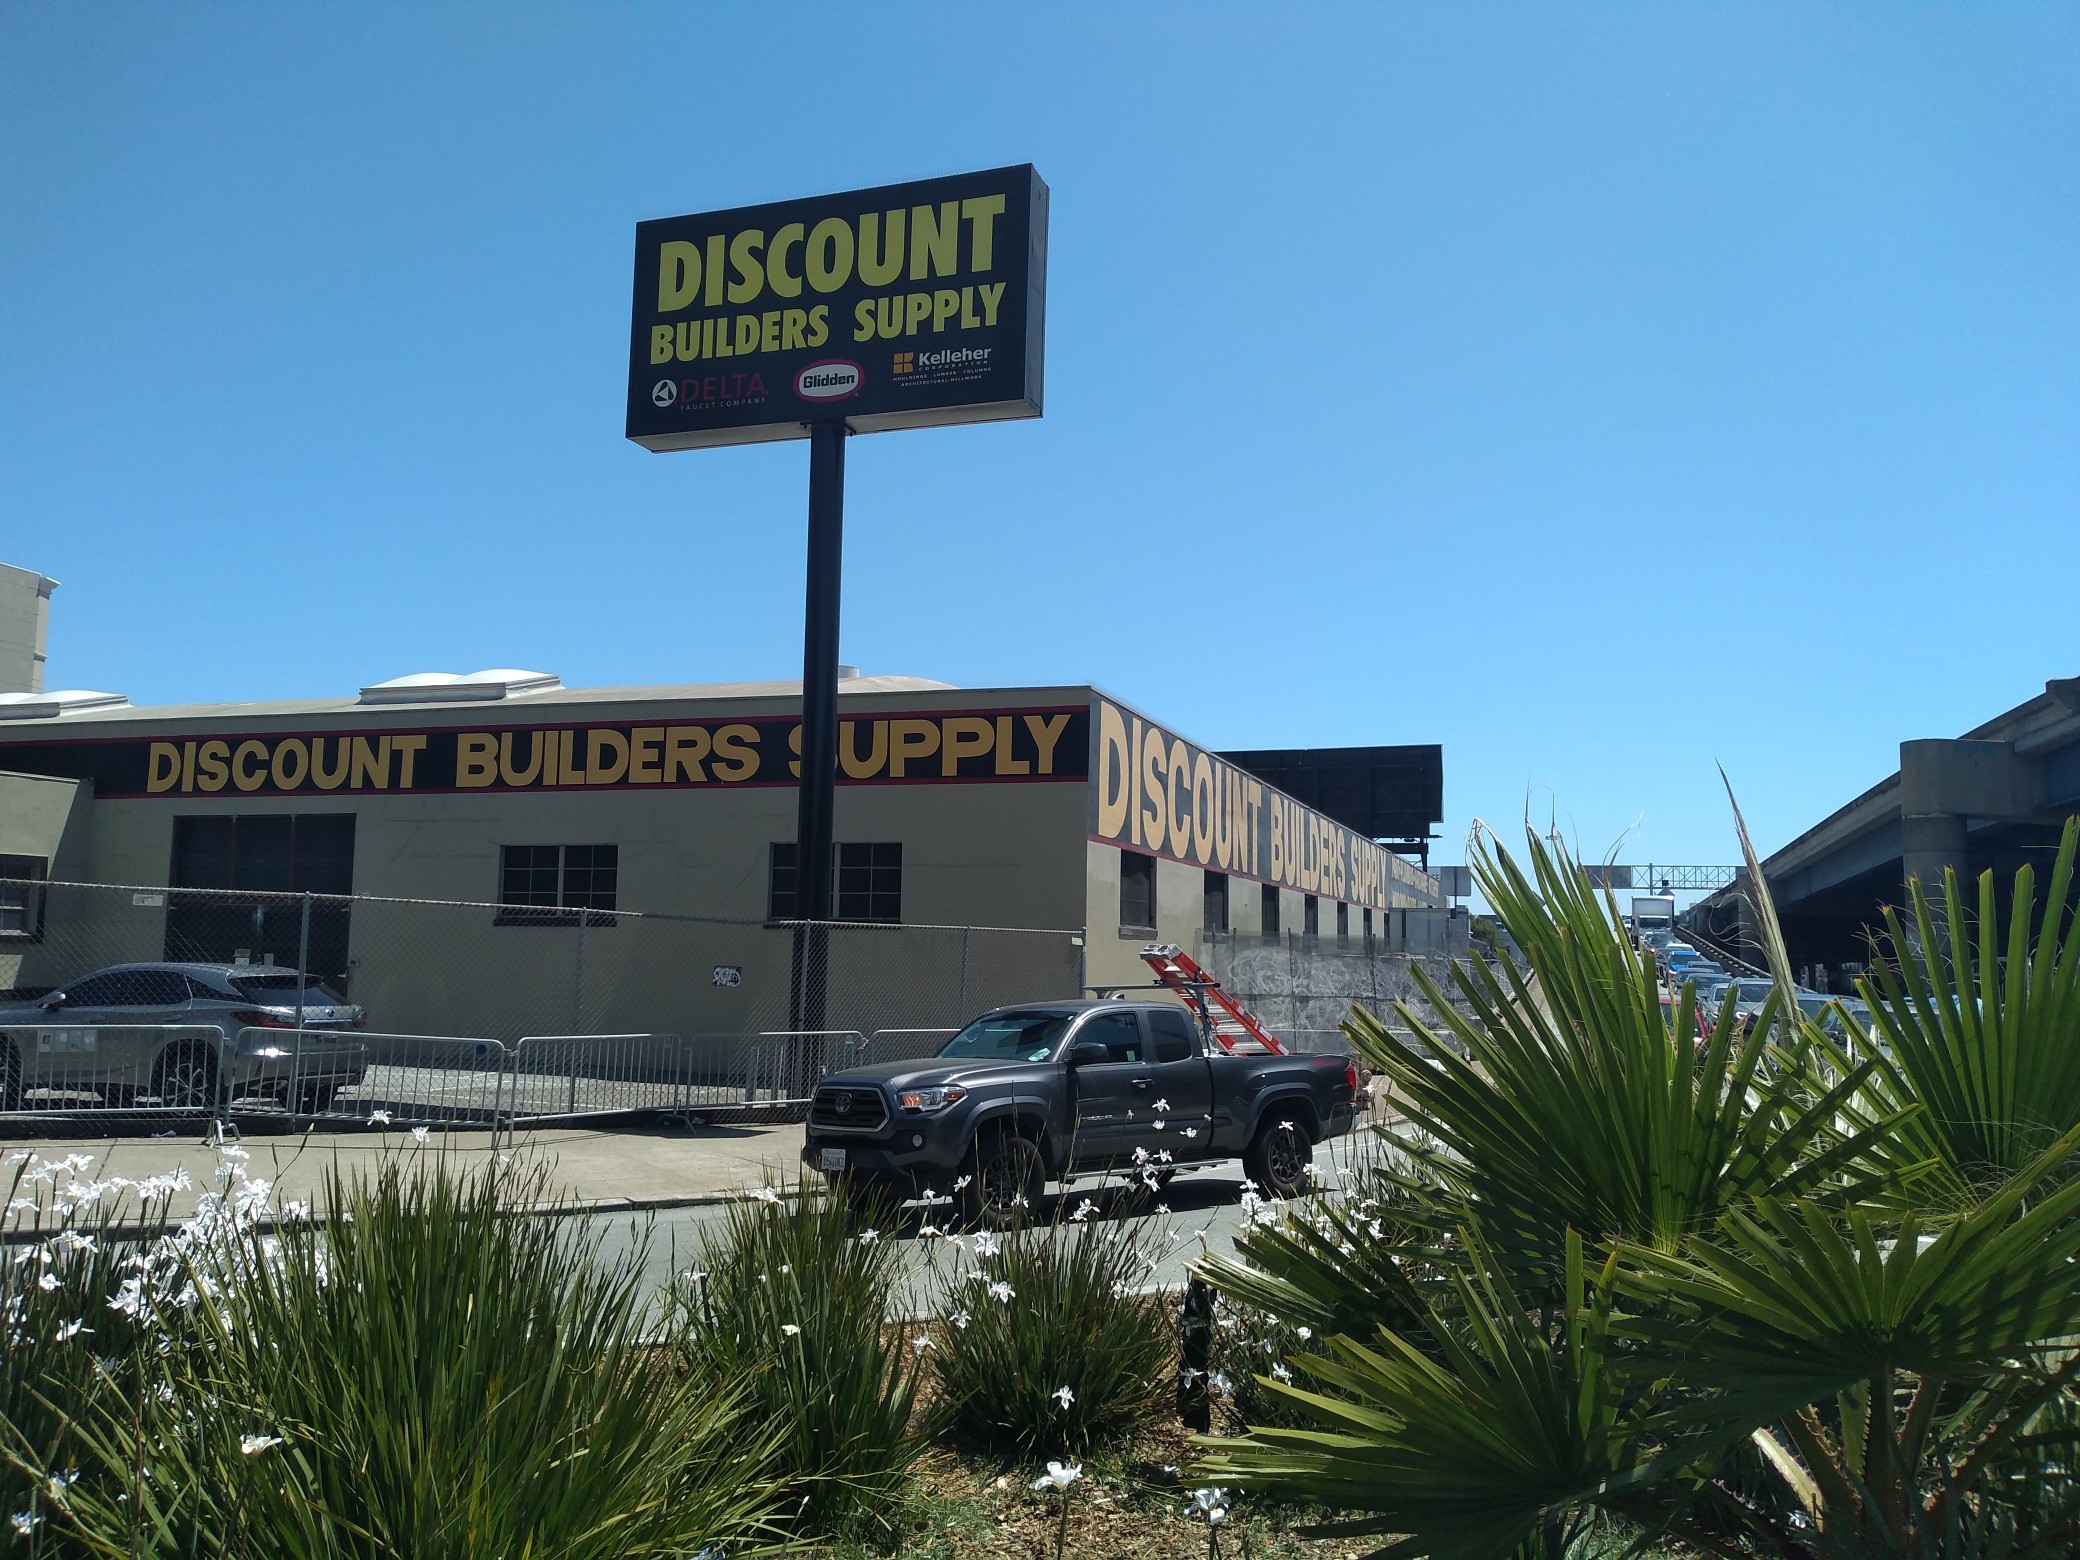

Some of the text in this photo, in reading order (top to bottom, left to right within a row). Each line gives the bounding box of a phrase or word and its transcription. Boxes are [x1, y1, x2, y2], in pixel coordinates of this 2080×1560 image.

[657, 193, 1006, 313] DISCOUNT
[650, 282, 1007, 365] BUILDERS SUPPLY
[918, 347, 992, 366] Kelleher
[918, 360, 988, 371] CORPORATION
[680, 372, 766, 404] DELTA
[803, 372, 855, 389] Glidden
[680, 398, 765, 411] FAUCET COMPANY
[146, 734, 427, 793] DISCOUNT
[456, 724, 761, 788] BUILDERS
[1098, 700, 1262, 876] DISCOUNT
[1270, 792, 1346, 900] BUILDERS
[1350, 834, 1387, 909] SUPPLY
